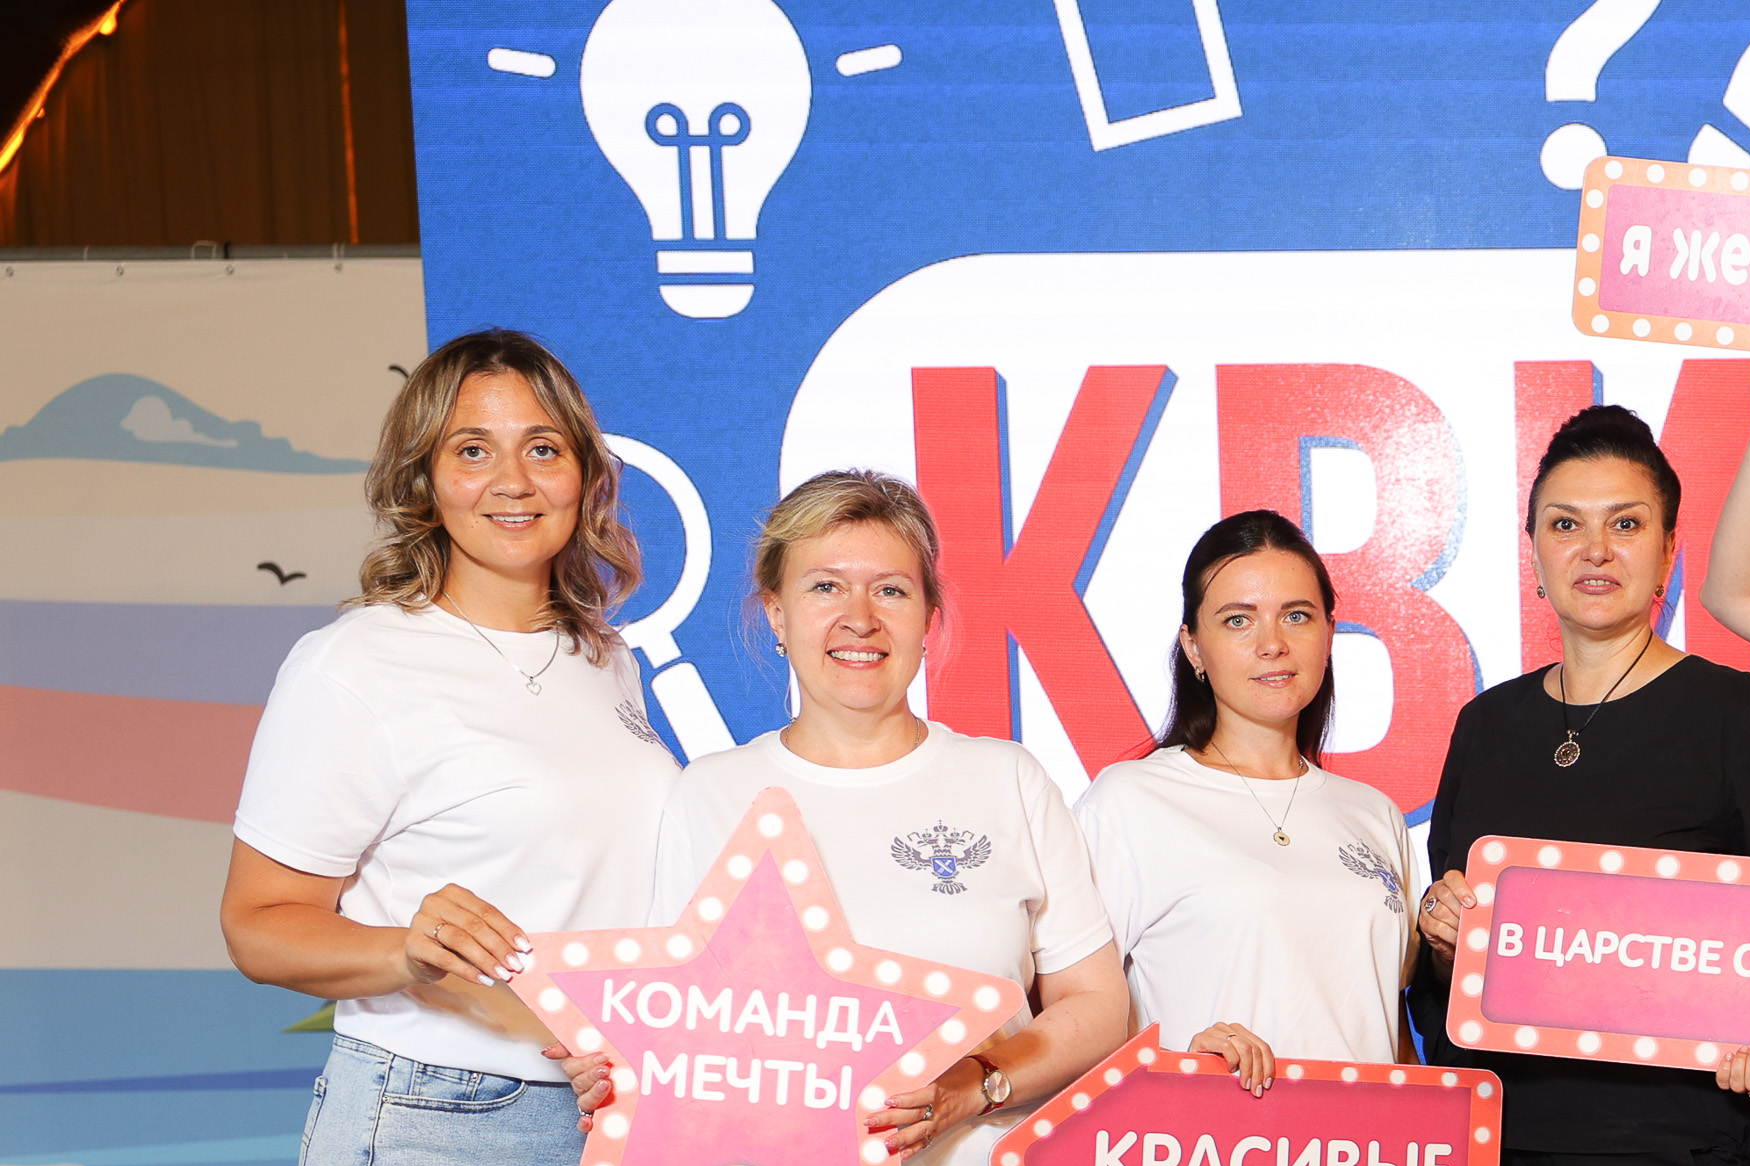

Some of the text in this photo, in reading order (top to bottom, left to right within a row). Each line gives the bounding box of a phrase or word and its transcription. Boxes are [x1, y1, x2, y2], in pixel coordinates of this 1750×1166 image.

[1496, 922, 1525, 958] В
[1533, 925, 1722, 976] ЦАРСТВЕ
[601, 977, 904, 1053] КОМАНДА
[640, 1050, 853, 1112] МЕЧТЫ
